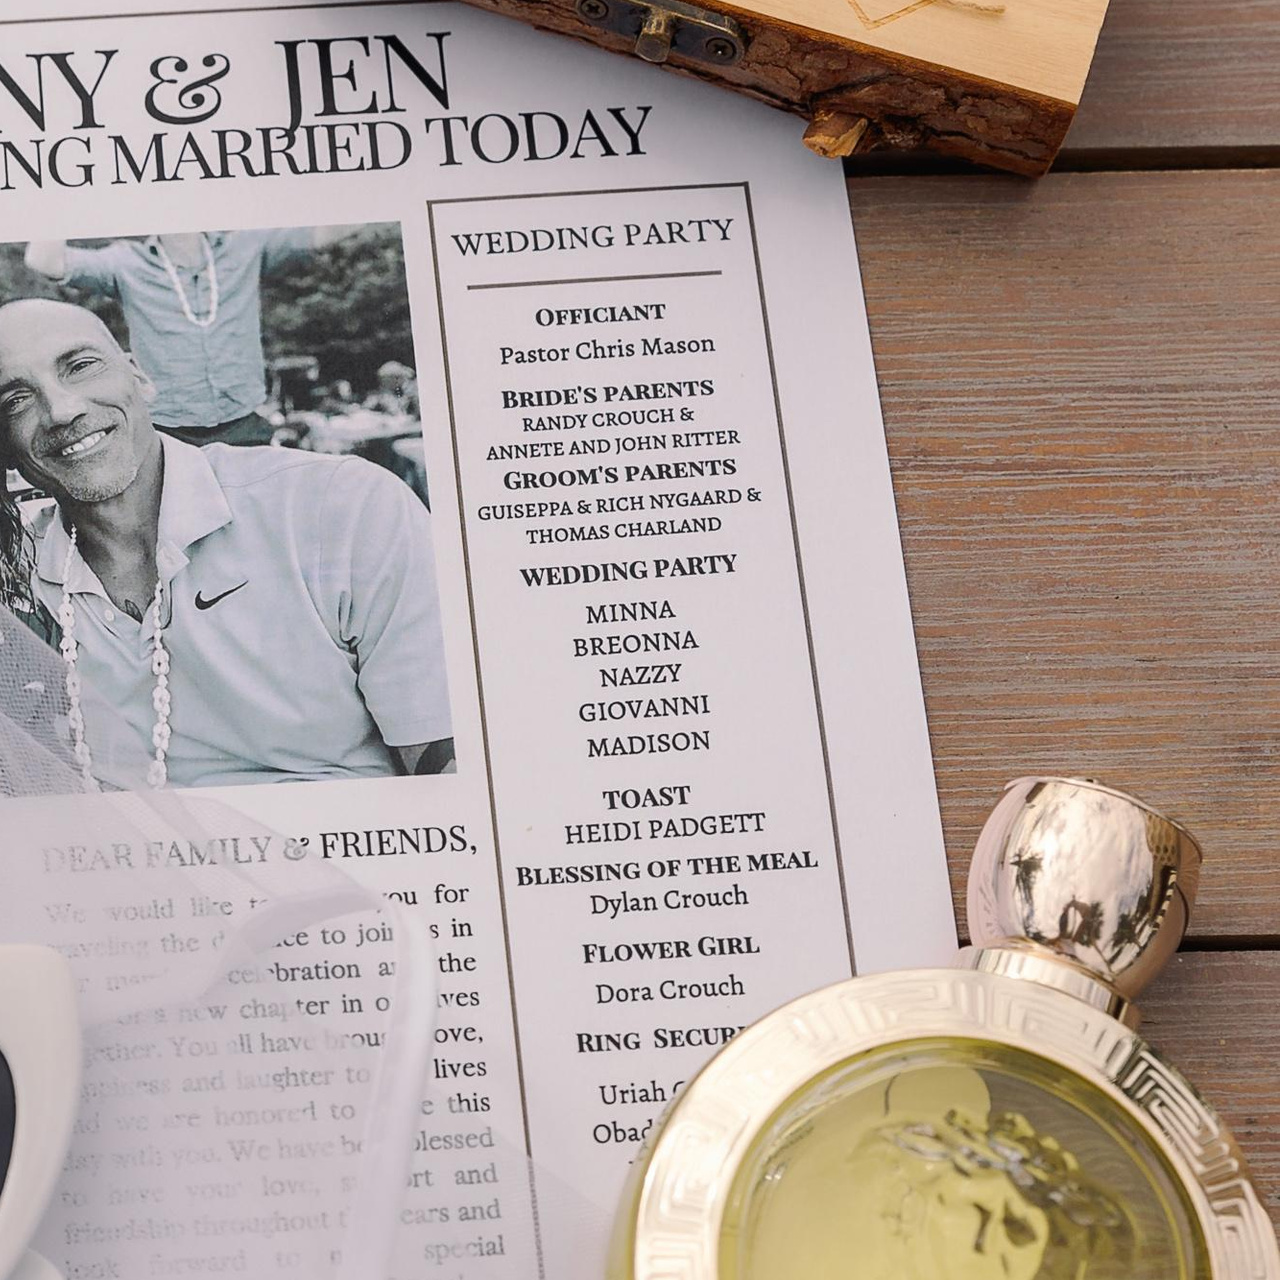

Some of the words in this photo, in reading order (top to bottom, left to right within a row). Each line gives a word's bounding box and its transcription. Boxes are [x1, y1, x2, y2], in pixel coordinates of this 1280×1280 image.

[144, 53, 230, 125] &
[275, 31, 452, 140] JEN
[109, 118, 412, 185] MARRIED
[425, 105, 653, 167] TODAY
[451, 225, 615, 257] WEDDING
[623, 218, 735, 246] PARTY
[535, 303, 666, 327] OFFICIANT
[499, 343, 570, 366] Pastor
[575, 338, 635, 361] Chris
[641, 335, 716, 356] Mason
[501, 384, 598, 409] BRIDE'S
[604, 378, 715, 403] PARENTS
[522, 413, 588, 433] RANDY
[591, 408, 675, 428] CROUCH
[679, 406, 695, 422] &
[486, 441, 564, 462] ANNETE
[568, 438, 611, 457] AND
[614, 434, 667, 456] JOHN
[672, 429, 741, 450] RITTER
[503, 466, 619, 490] GROOM'S
[625, 458, 737, 482] PARENTS
[477, 500, 574, 521] GUISEPPA
[577, 499, 592, 515] &
[596, 494, 645, 515] RICH
[649, 488, 741, 510] NYGAARD
[746, 486, 762, 502] &
[526, 524, 610, 545] THOMAS
[614, 516, 722, 540] CHARLAND
[520, 560, 648, 588] WEDDING
[653, 554, 738, 579] PARTY
[585, 600, 677, 625] MINNA
[573, 630, 700, 658] BREONNA
[599, 663, 683, 688] NAZZY
[578, 694, 711, 722] GIOVANNI
[587, 730, 711, 758] MADISON
[602, 785, 691, 810] TOAST
[565, 821, 642, 845] HEIDI
[648, 812, 767, 840] PADGETT
[144, 836, 272, 868] FAMILY
[281, 836, 311, 861] &
[320, 825, 478, 860] FRIENDS,
[516, 862, 641, 887] BLESSING
[646, 860, 681, 879] OF
[686, 856, 742, 877] THE
[746, 850, 819, 873] MEAL
[434, 883, 470, 904] for
[590, 891, 658, 919] Dylan
[663, 884, 750, 910] Crouch
[320, 928, 346, 945] to
[451, 918, 474, 938] in
[438, 952, 477, 973] the
[582, 940, 693, 965] FLOWER
[697, 935, 761, 957] GIRL
[596, 982, 655, 1004] Dora
[659, 974, 746, 1000] Crouch
[342, 993, 364, 1014] in
[434, 1025, 484, 1044] ove,
[576, 1032, 642, 1054] RING
[433, 1058, 488, 1079] lives
[447, 1092, 491, 1114] this
[599, 1080, 666, 1105] Uriah
[454, 1162, 499, 1186] and
[457, 1198, 502, 1222] and
